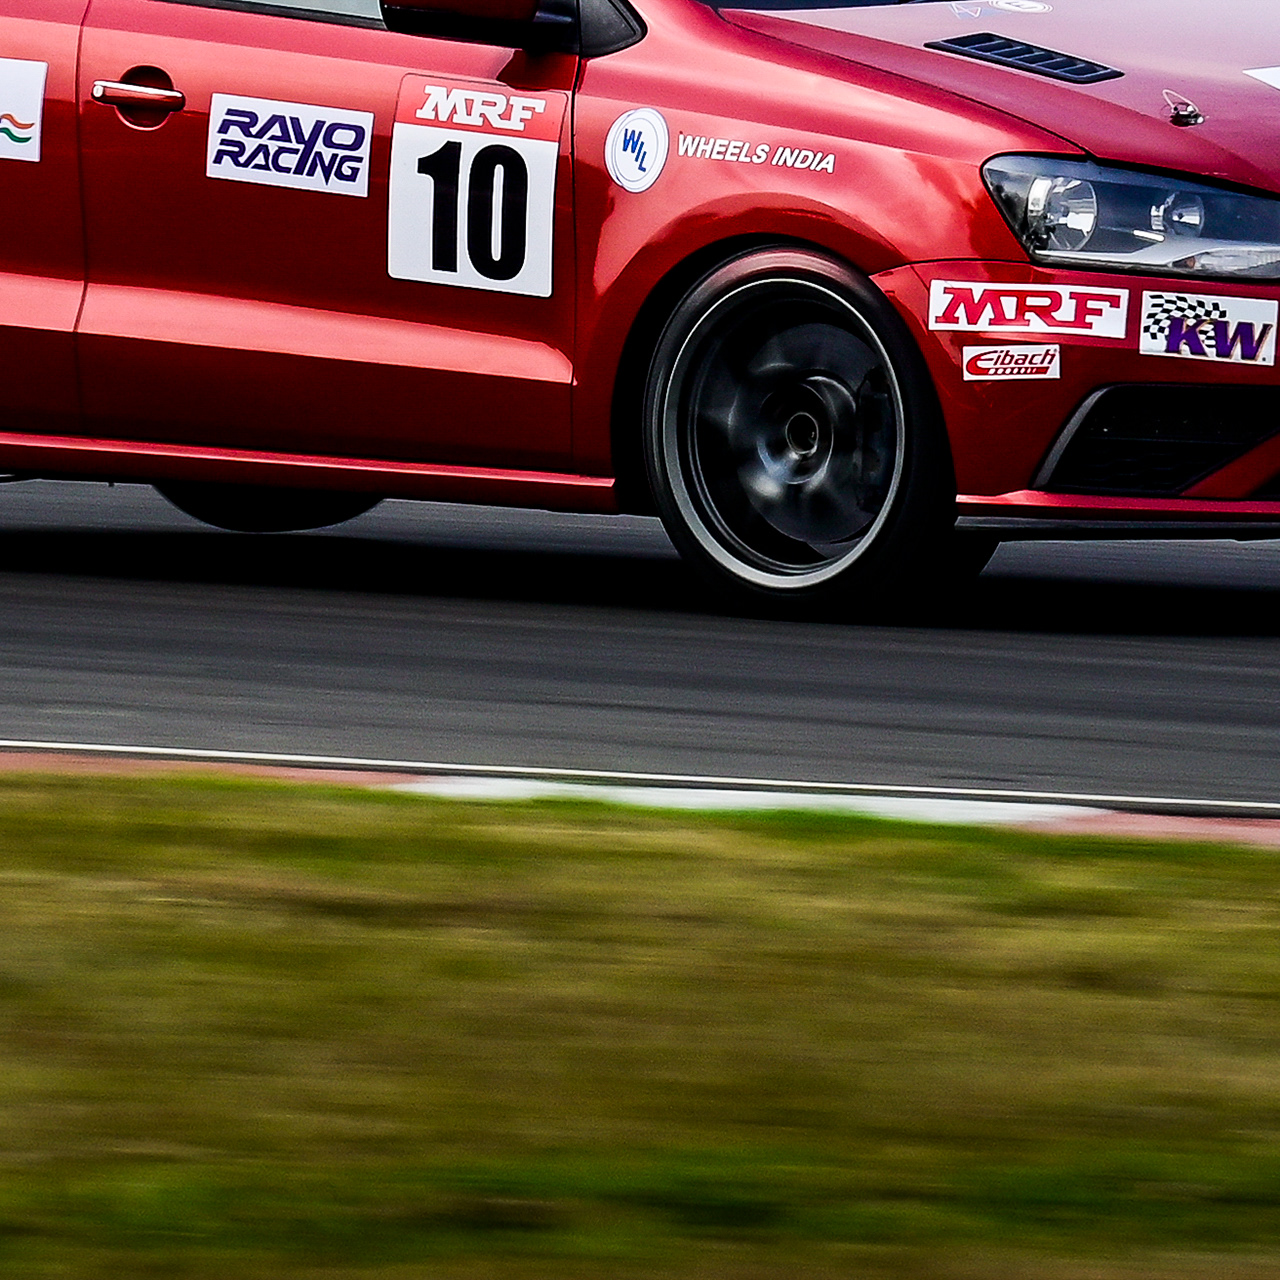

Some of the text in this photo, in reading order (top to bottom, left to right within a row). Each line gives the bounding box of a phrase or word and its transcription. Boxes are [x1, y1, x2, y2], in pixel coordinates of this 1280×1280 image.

[216, 107, 366, 153] RAYO
[415, 85, 547, 132] MRF
[212, 138, 364, 186] RACING
[622, 127, 648, 173] WIL
[677, 132, 837, 174] WHEELS INDIA
[417, 140, 529, 281] 10
[934, 287, 1121, 329] MRF
[965, 348, 1057, 376] Eibach
[1164, 318, 1273, 361] KW
